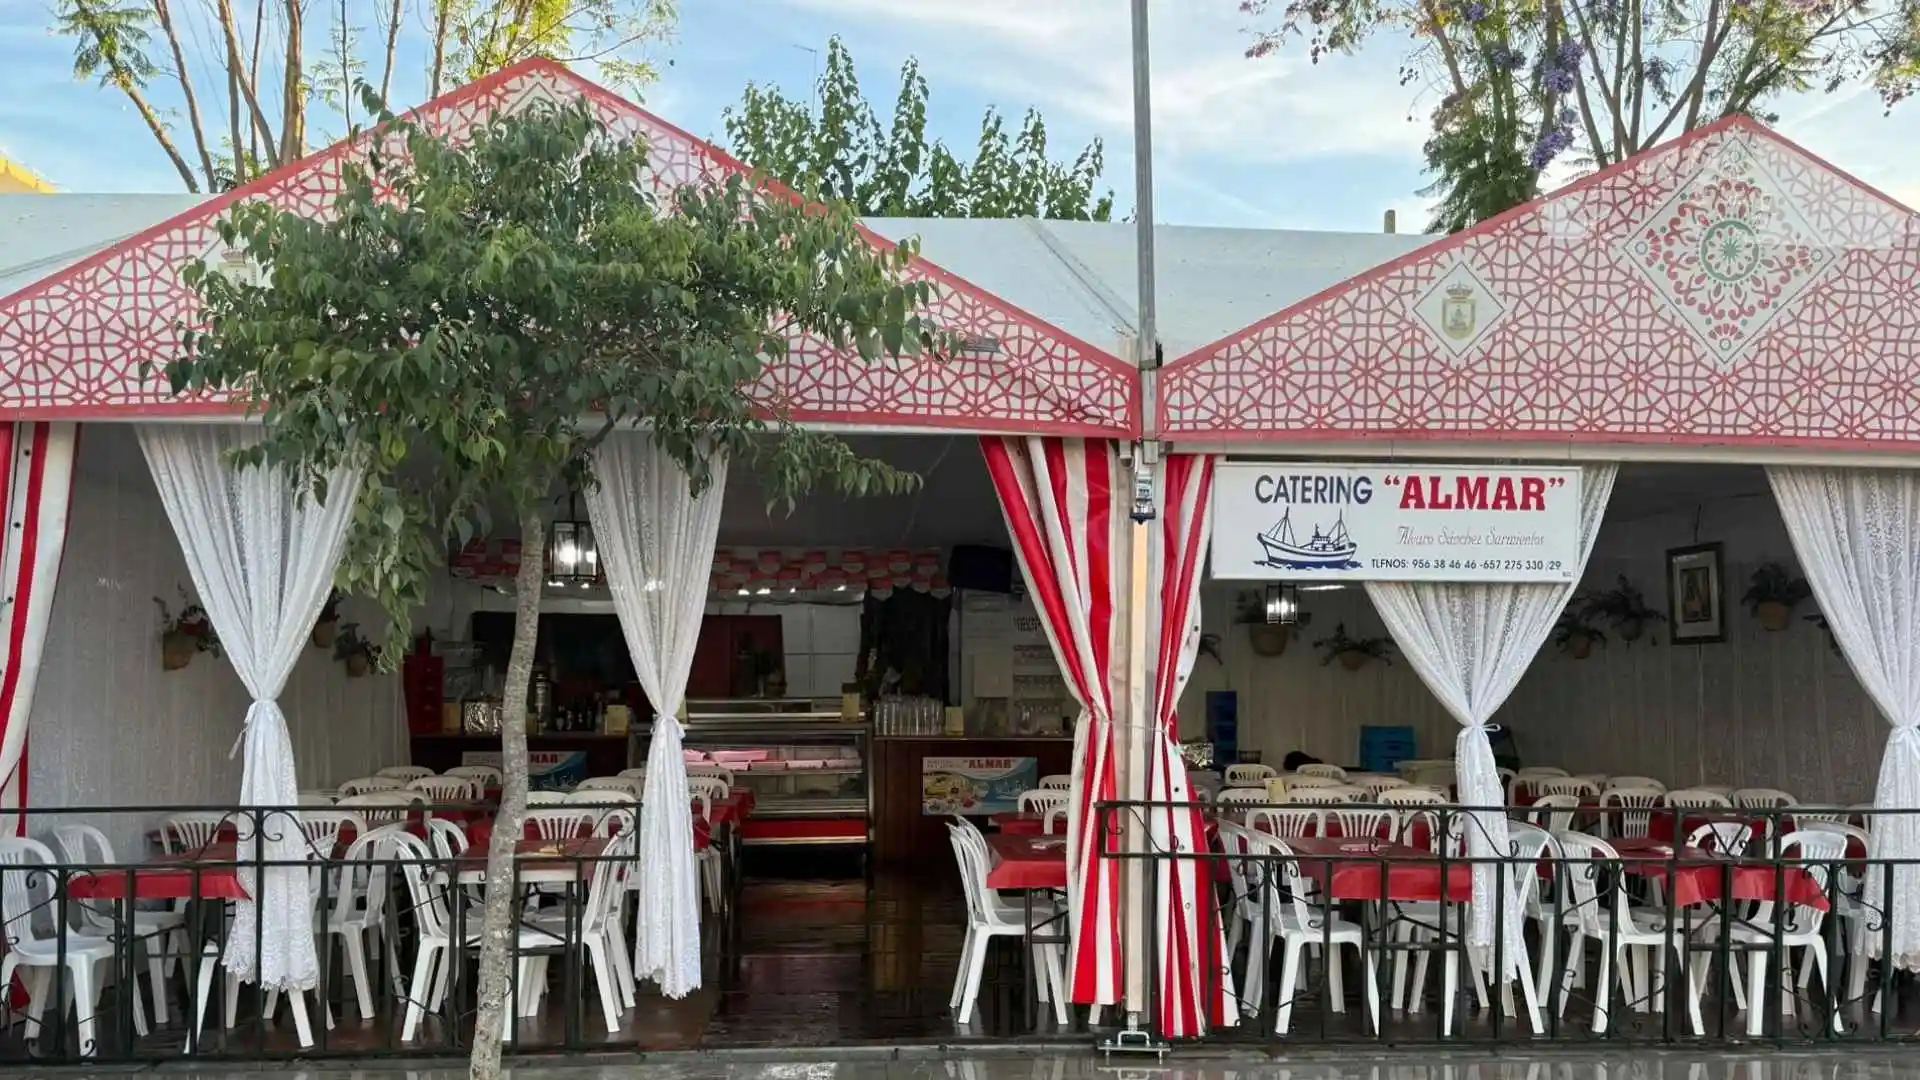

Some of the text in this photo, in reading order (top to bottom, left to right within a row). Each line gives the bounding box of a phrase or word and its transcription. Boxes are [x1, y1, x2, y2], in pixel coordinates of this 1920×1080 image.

[1255, 475, 1373, 504] CATERING
[1371, 558, 1409, 569] TLFNOS:
[1412, 558, 1430, 569] 956
[1433, 558, 1446, 569] 38
[1448, 559, 1461, 569] 46
[1464, 559, 1477, 569] 46
[1504, 559, 1522, 570] 275
[1525, 560, 1543, 570] 330
